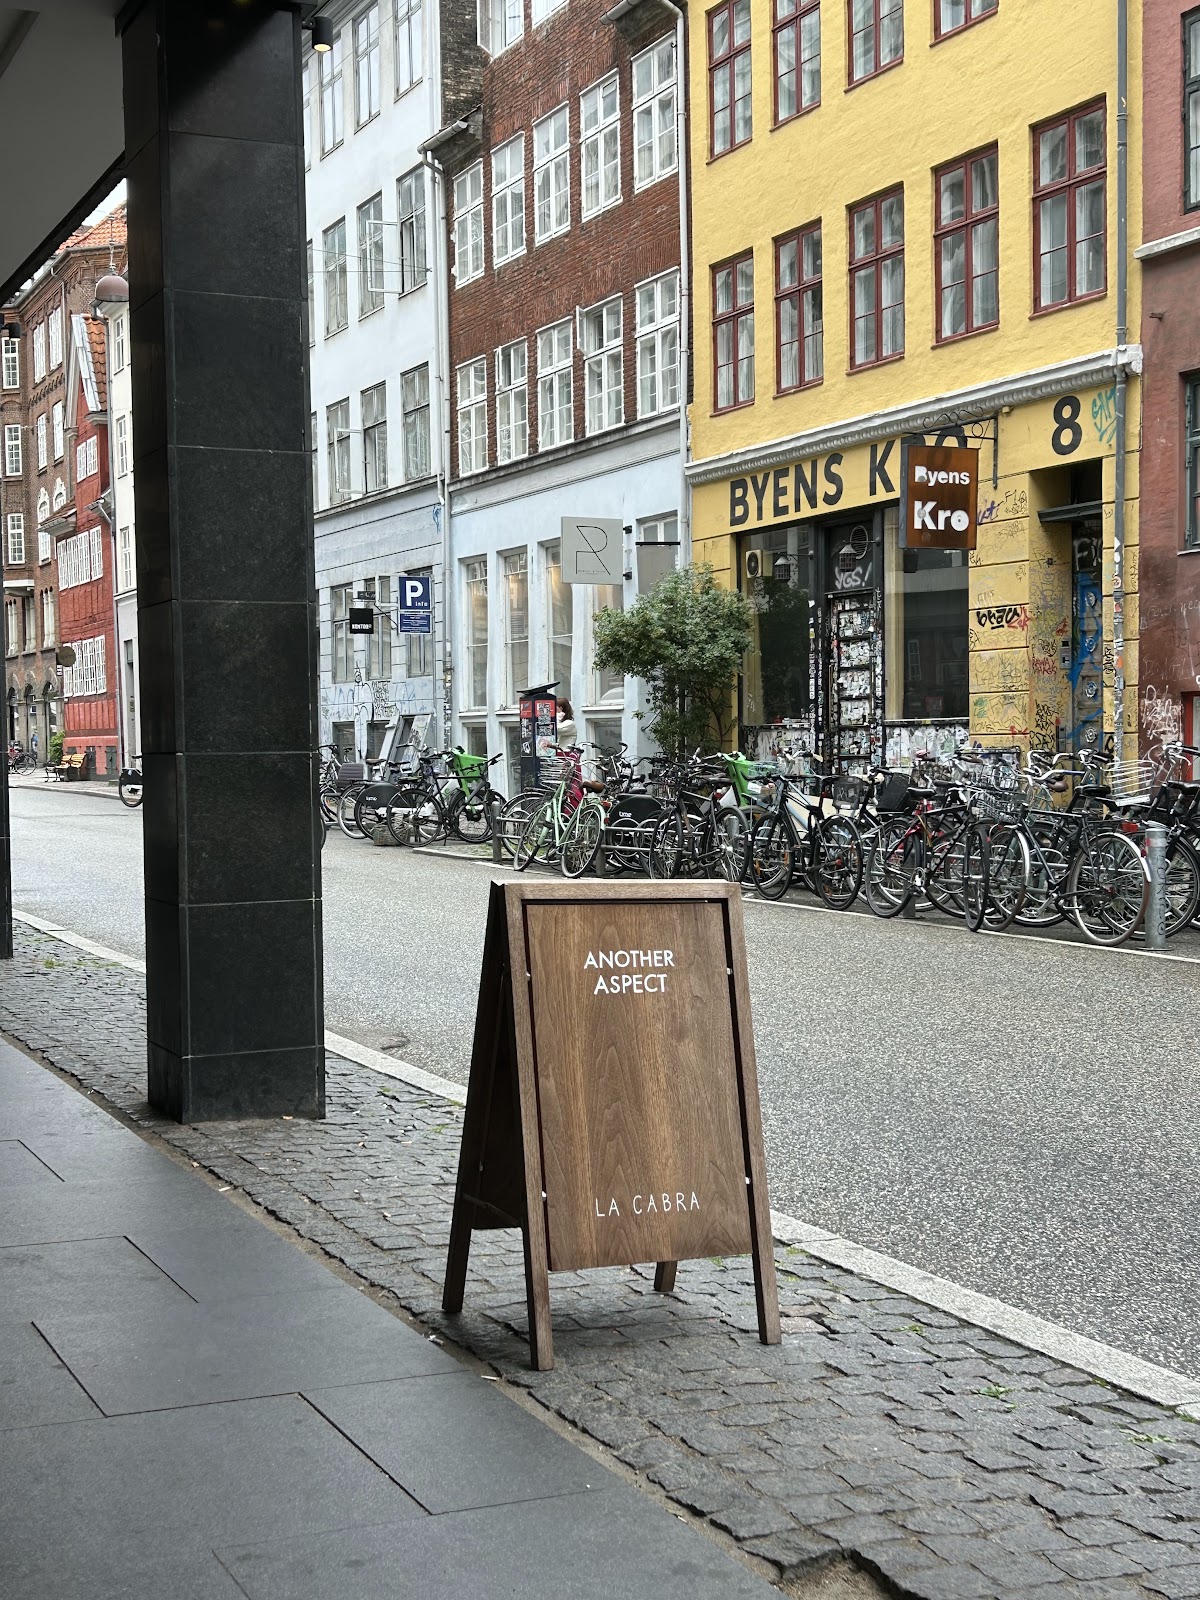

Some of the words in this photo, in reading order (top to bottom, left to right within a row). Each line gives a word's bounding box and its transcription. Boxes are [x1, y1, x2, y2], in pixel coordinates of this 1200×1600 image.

[1051, 395, 1082, 456] 8
[914, 465, 970, 487] Byens
[729, 453, 844, 527] BYENS
[913, 500, 970, 532] Kro
[405, 580, 424, 607] P
[583, 949, 675, 970] ANOTHER
[593, 973, 668, 995] ASPECT
[595, 1197, 620, 1217] LA
[632, 1191, 700, 1215] CABRA
